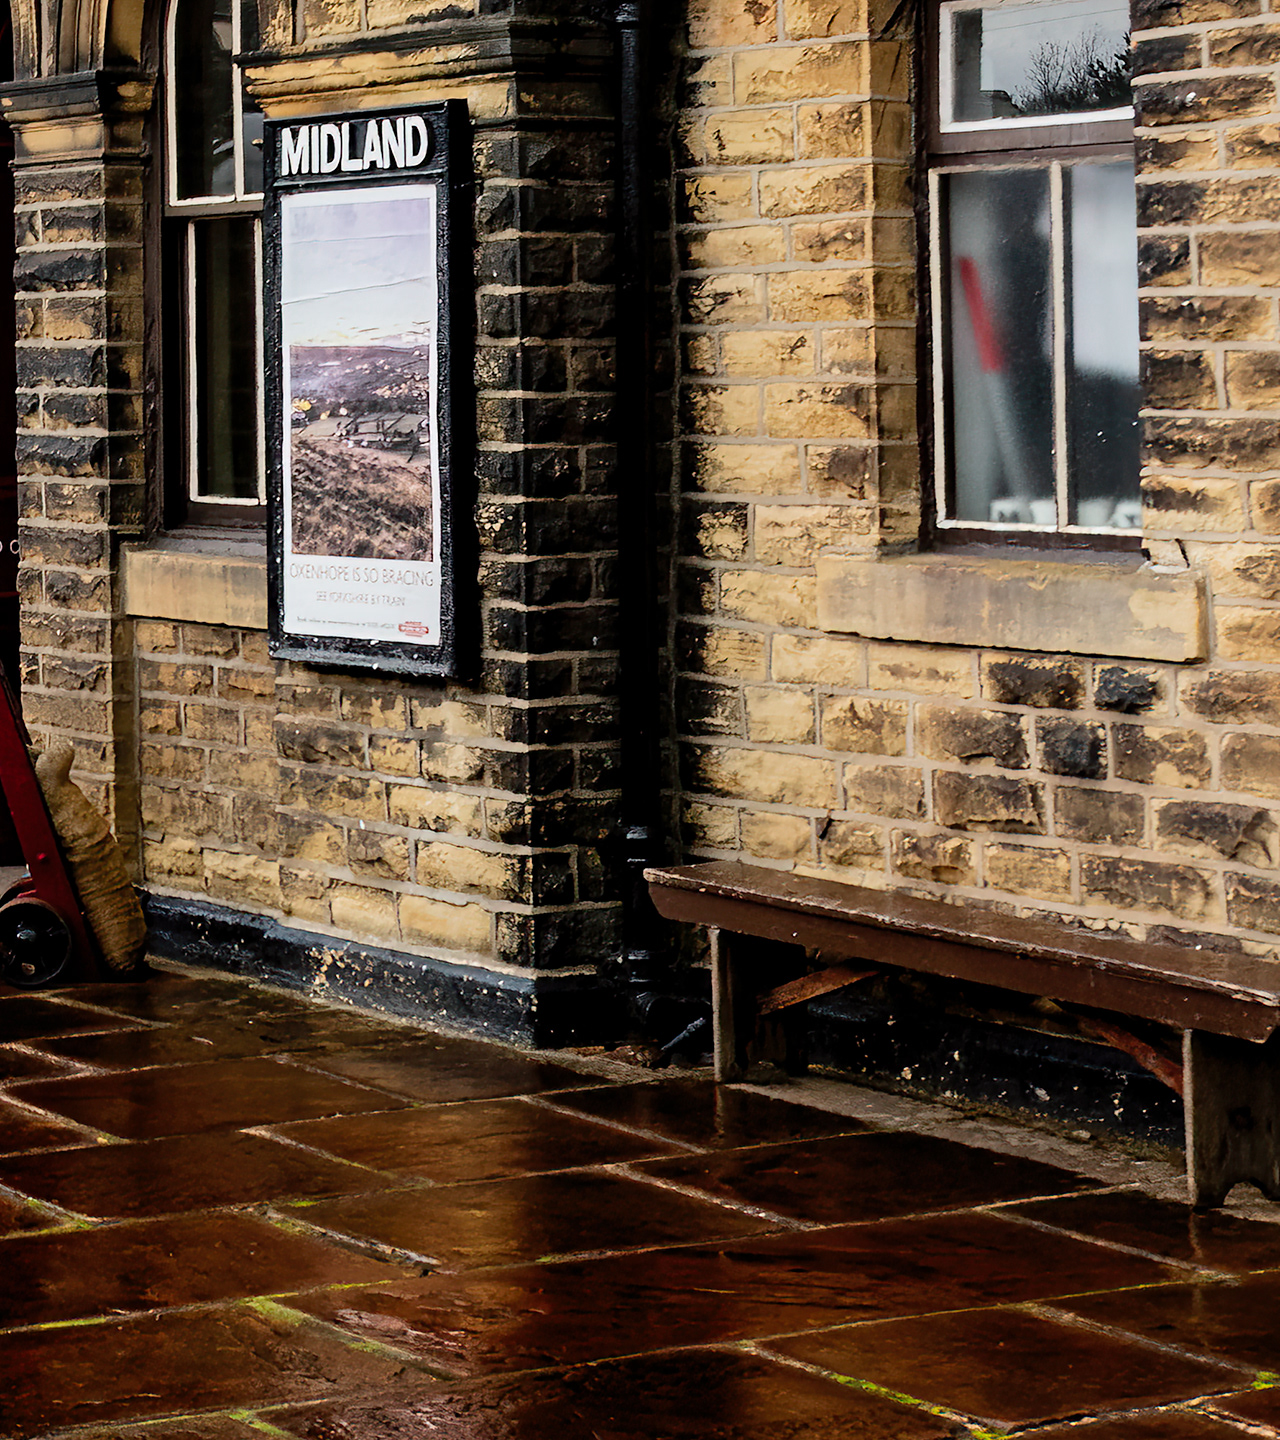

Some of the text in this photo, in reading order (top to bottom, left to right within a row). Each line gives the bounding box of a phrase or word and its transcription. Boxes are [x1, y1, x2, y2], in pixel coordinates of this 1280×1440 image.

[281, 115, 428, 176] MIDLAND
[290, 563, 433, 587] OXENHOPE IS SO BRACING
